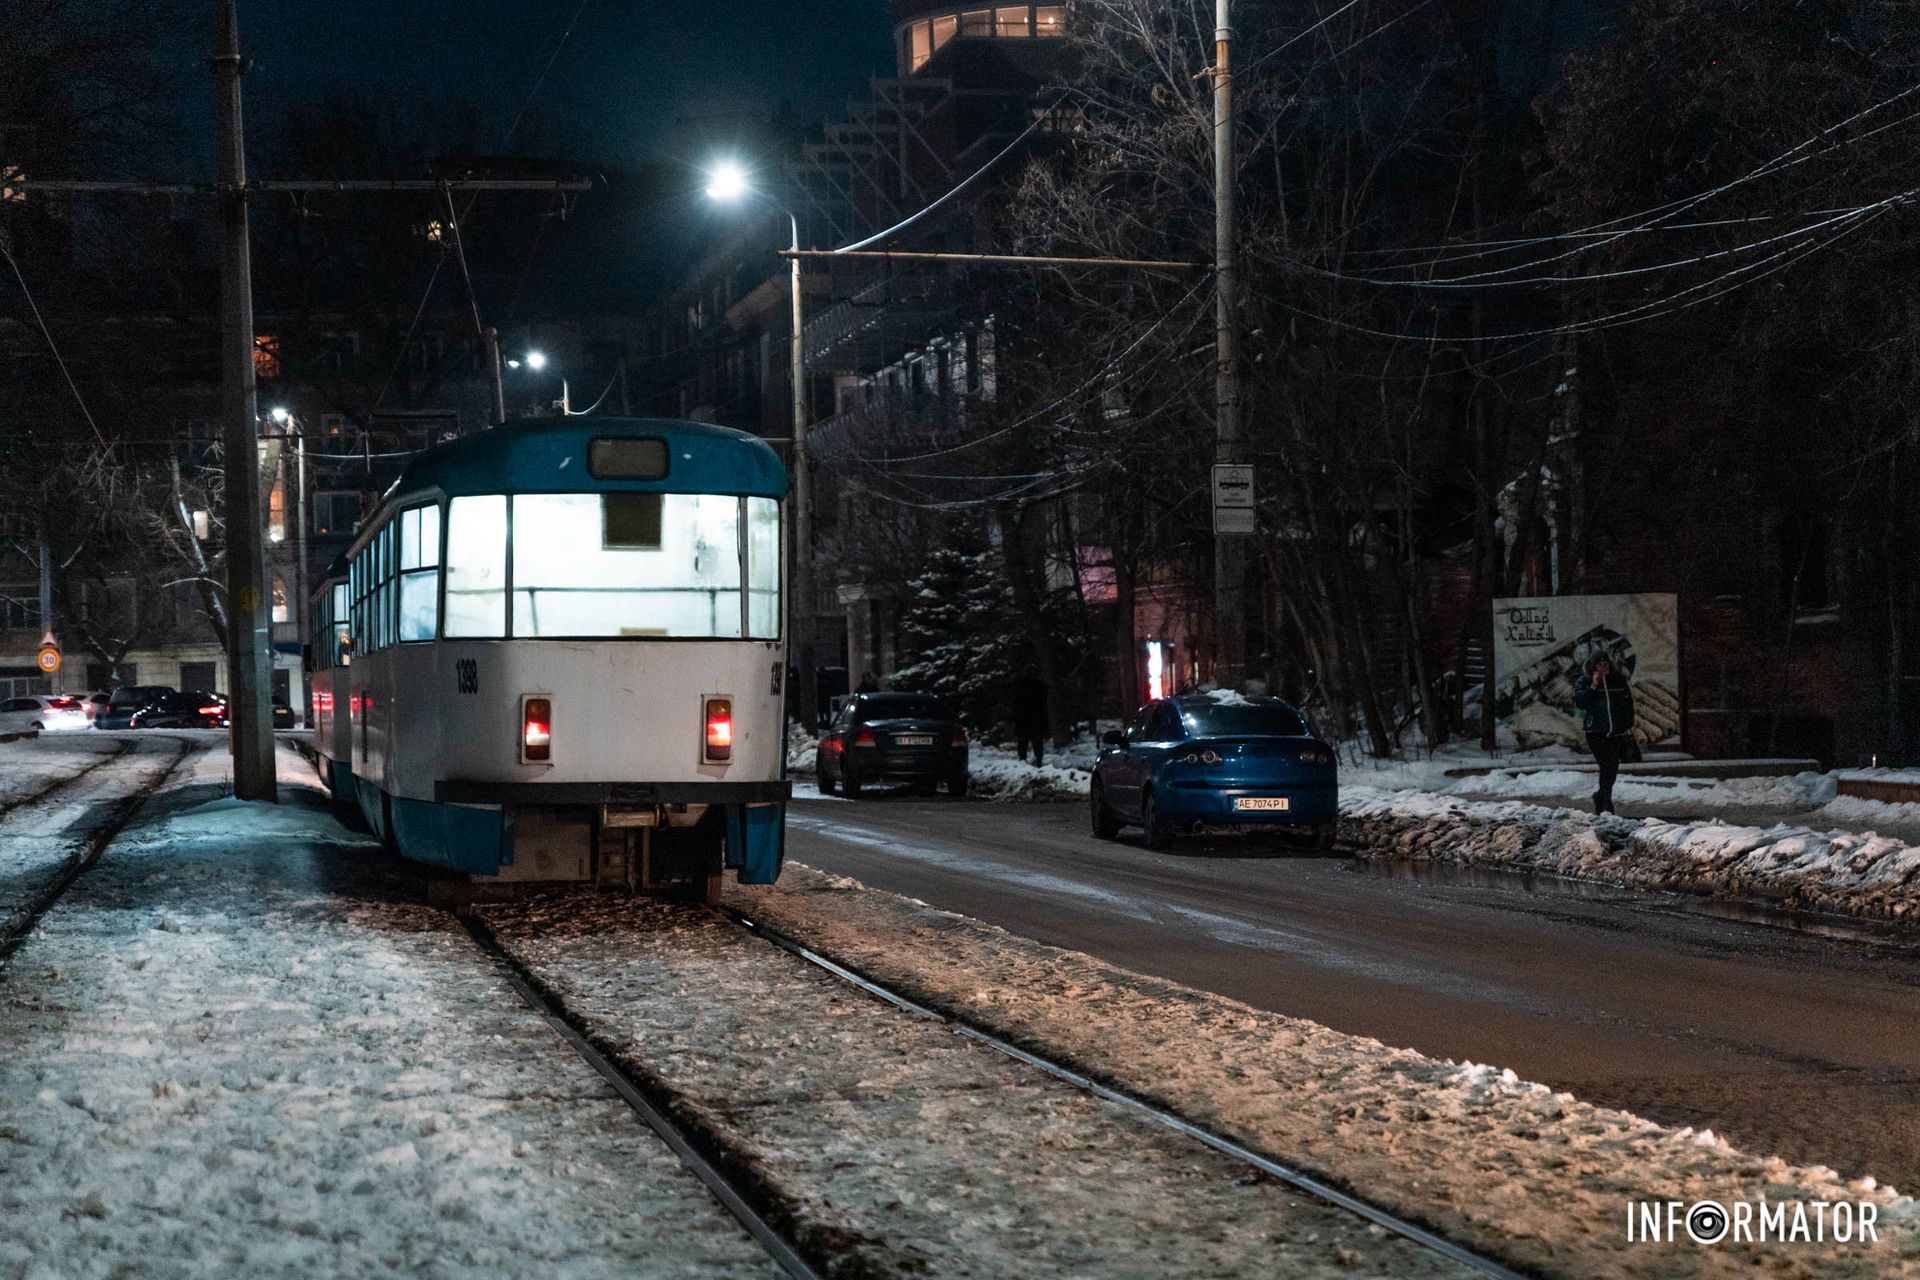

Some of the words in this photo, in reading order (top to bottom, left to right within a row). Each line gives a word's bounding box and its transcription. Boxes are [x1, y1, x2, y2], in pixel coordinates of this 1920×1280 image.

[44, 656, 55, 665] 30
[456, 658, 478, 695] 1398
[1239, 799, 1251, 809] AE
[1252, 799, 1272, 809] 7074
